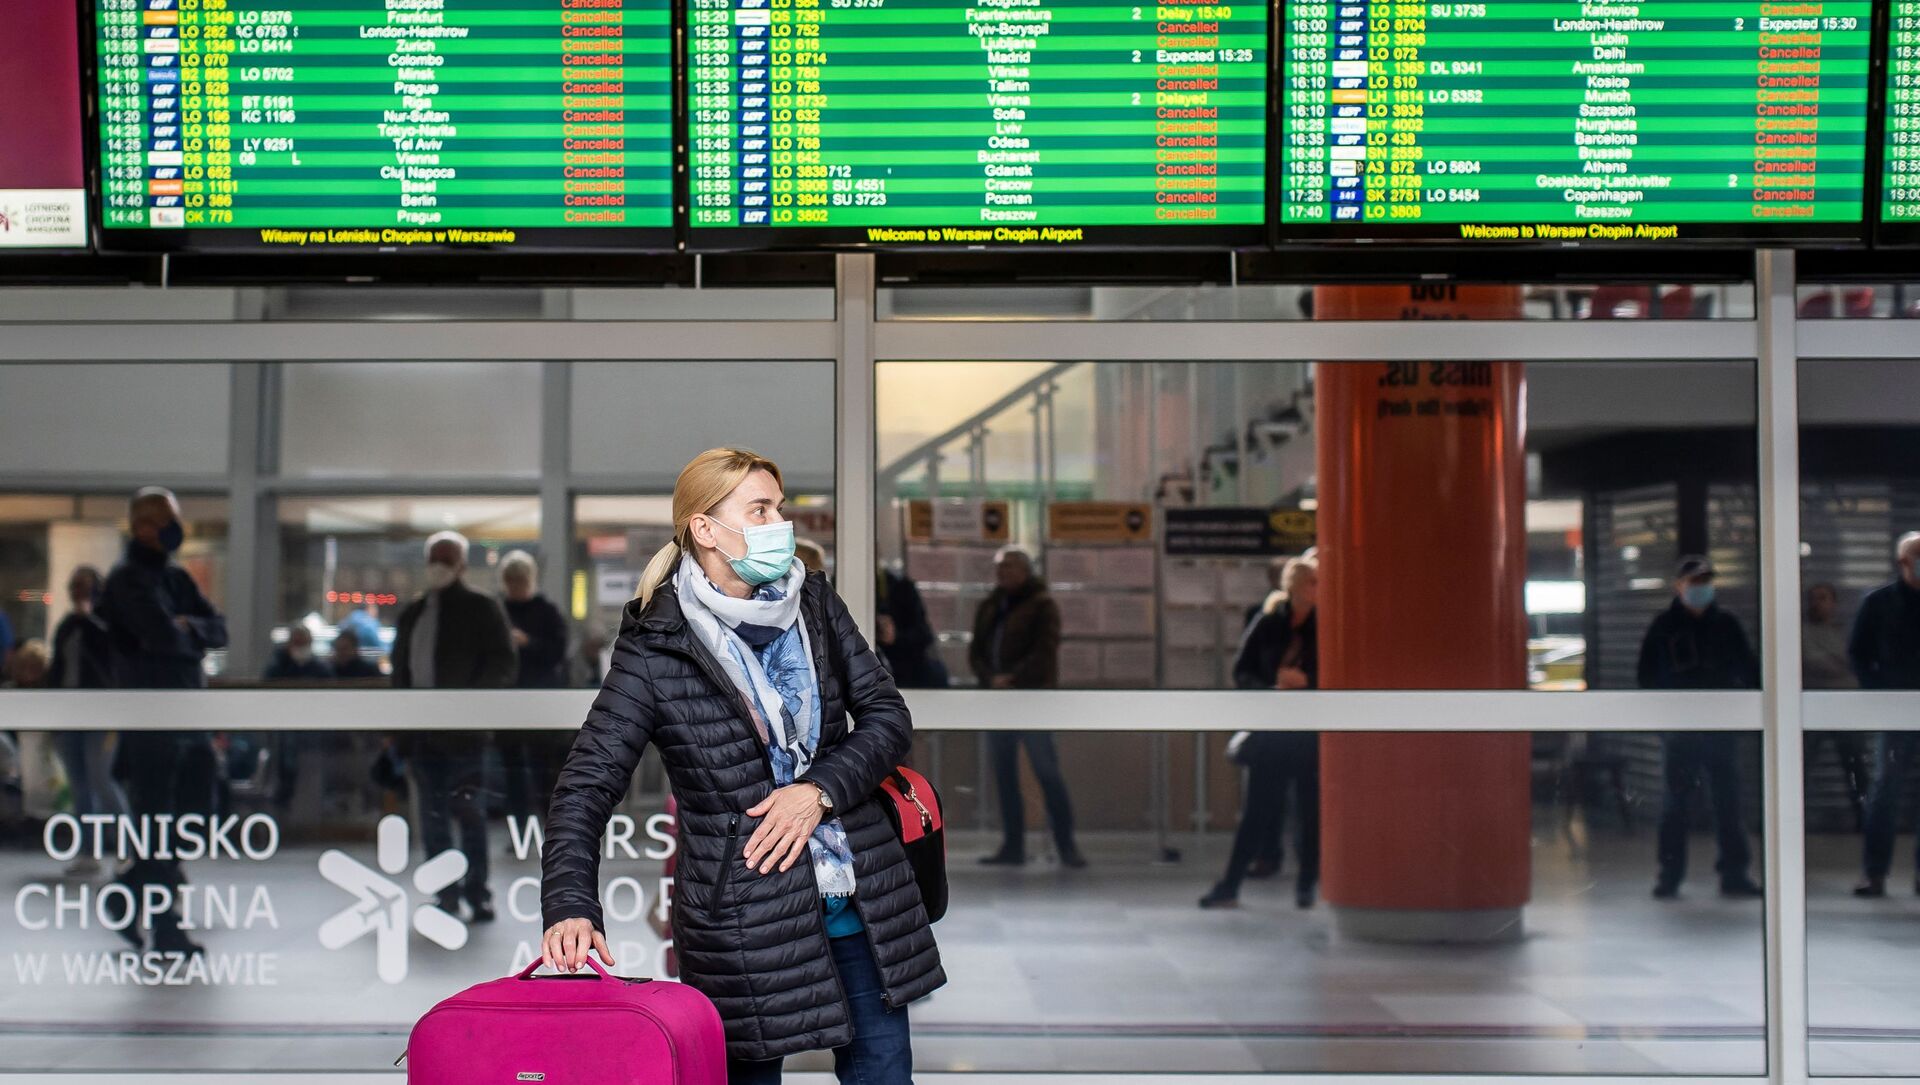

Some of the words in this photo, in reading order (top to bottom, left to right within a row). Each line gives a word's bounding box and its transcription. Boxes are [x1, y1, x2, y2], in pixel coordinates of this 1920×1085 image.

[694, 0, 729, 10] 15:15
[831, 0, 852, 9] SU
[854, 0, 884, 9] 3737
[1292, 5, 1328, 18] 16:00
[1431, 5, 1451, 17] SU
[1454, 5, 1486, 17] 3735
[1582, 4, 1639, 17] Katowice
[387, 11, 443, 24] Frankfurt
[694, 11, 729, 23] 15:20
[965, 8, 1052, 21] Fuerteventura
[1132, 8, 1141, 20] 2
[1157, 7, 1193, 22] Delay
[1197, 7, 1232, 20] 15:40
[359, 25, 469, 38] London-Heathrow
[694, 24, 729, 37] 15:25
[968, 22, 1049, 37] Kyiv-Boryspil
[1157, 21, 1219, 33] Cancelled
[1292, 19, 1327, 32] 16:00
[1554, 18, 1665, 31] London-Heathrow
[1735, 18, 1744, 30] 2
[1760, 18, 1819, 33] Expected
[1823, 18, 1857, 30] 15:30
[396, 39, 436, 52] Zurich
[694, 39, 729, 51] 15:30
[1292, 34, 1327, 46] 16:00
[1591, 33, 1629, 46] Lublin
[388, 54, 444, 66] Colombo
[562, 54, 623, 66] Cancelled
[694, 53, 730, 65] 15:30
[987, 51, 1031, 63] Madrid
[1132, 50, 1141, 63] 2
[1156, 50, 1215, 65] Expected
[1218, 49, 1253, 62] 15:25
[1290, 48, 1327, 60] 16:05
[1593, 47, 1626, 60] Delhi
[1759, 47, 1821, 59] Cancelled
[694, 67, 730, 80] 15:30
[988, 65, 1030, 78] Vilnius
[1290, 62, 1326, 74] 16:10
[1573, 61, 1645, 74] Amsterdam
[696, 81, 730, 94] 15:35
[988, 79, 1030, 92] Tallinn
[1290, 76, 1326, 89] 16:10
[1587, 75, 1630, 88] Kosice
[394, 82, 439, 97] Prague
[562, 82, 624, 94] Cancelled
[1290, 90, 1326, 103] 16:10
[1585, 90, 1631, 102] Munich
[694, 95, 730, 108] 15:35
[986, 93, 1031, 106] Vienna
[1131, 93, 1141, 105] 2
[1156, 92, 1208, 108] Delayed
[383, 110, 450, 122] Nur-Sultan
[696, 110, 730, 122] 15:40
[993, 108, 1026, 120] Sofia
[1156, 107, 1218, 119] Cancelled
[1290, 105, 1326, 117] 16:10
[1580, 104, 1636, 117] Szczecin
[1756, 104, 1818, 116] Cancelled
[377, 124, 457, 139] Tokyo-Narita
[696, 123, 730, 136] 15:45
[996, 122, 1022, 134] Lviv
[1290, 119, 1325, 132] 16:25
[1575, 118, 1637, 133] Hurghada
[393, 138, 414, 151] Tel
[415, 138, 443, 151] Aviv
[563, 138, 624, 151] Cancelled
[696, 138, 730, 150] 15:45
[988, 136, 1030, 149] Odesa
[1290, 133, 1325, 146] 16:35
[1575, 133, 1638, 145] Barcelona
[396, 152, 440, 165] Vienna
[696, 152, 731, 164] 15:45
[977, 150, 1041, 163] Bucharest
[1290, 147, 1325, 160] 16:40
[1578, 147, 1633, 159] Brussels
[380, 166, 405, 182] Cluj
[407, 166, 456, 182] Napoca
[696, 166, 731, 178] 15:55
[984, 164, 1033, 177] Gdansk
[1156, 163, 1217, 176] Cancelled
[1288, 161, 1324, 174] 16:55
[1583, 161, 1628, 173] Athens
[1754, 161, 1816, 173] Cancelled
[696, 180, 731, 192] 15:55
[832, 179, 852, 192] SU
[854, 179, 885, 191] 4551
[984, 178, 1033, 191] Cracow
[1288, 175, 1324, 188] 17:20
[1728, 175, 1738, 187] 2
[401, 194, 437, 207] Berlin
[564, 194, 625, 207] Cancelled
[696, 193, 731, 206] 15:55
[832, 193, 853, 205] SU
[855, 193, 887, 205] 3723
[985, 192, 1033, 205] Poznan
[1288, 189, 1324, 202] 17:25
[1427, 189, 1446, 201] LO
[1449, 189, 1480, 201] 5454
[1564, 189, 1643, 204] Copenhagen
[397, 210, 441, 225] Prague
[696, 210, 731, 223] 15:55
[980, 208, 1037, 221] Rzeszow
[1288, 205, 1323, 218] 17:40
[1575, 205, 1633, 218] Rzeszow
[1753, 205, 1814, 218] Cancelled
[261, 229, 306, 245] Witamy
[310, 231, 326, 242] na
[328, 229, 380, 242] Lotnisku
[381, 229, 433, 245] Chopina
[435, 232, 446, 242] w
[448, 229, 515, 242] Warszawie
[867, 228, 926, 241] Welcome
[928, 229, 941, 240] to
[942, 228, 992, 240] Warsaw
[994, 227, 1038, 243] Chopin
[1040, 227, 1083, 243] Airport
[1461, 225, 1519, 238] Welcome
[1521, 225, 1534, 237] to
[1536, 224, 1587, 237] Warsaw
[1588, 223, 1633, 240] Chopin
[1635, 223, 1678, 240] Airport
[43, 813, 279, 860] OTNISKO
[507, 814, 677, 860] WRS
[14, 883, 279, 930] CHOPINA
[14, 952, 48, 984] W
[62, 952, 278, 985] WARSZAWIE
